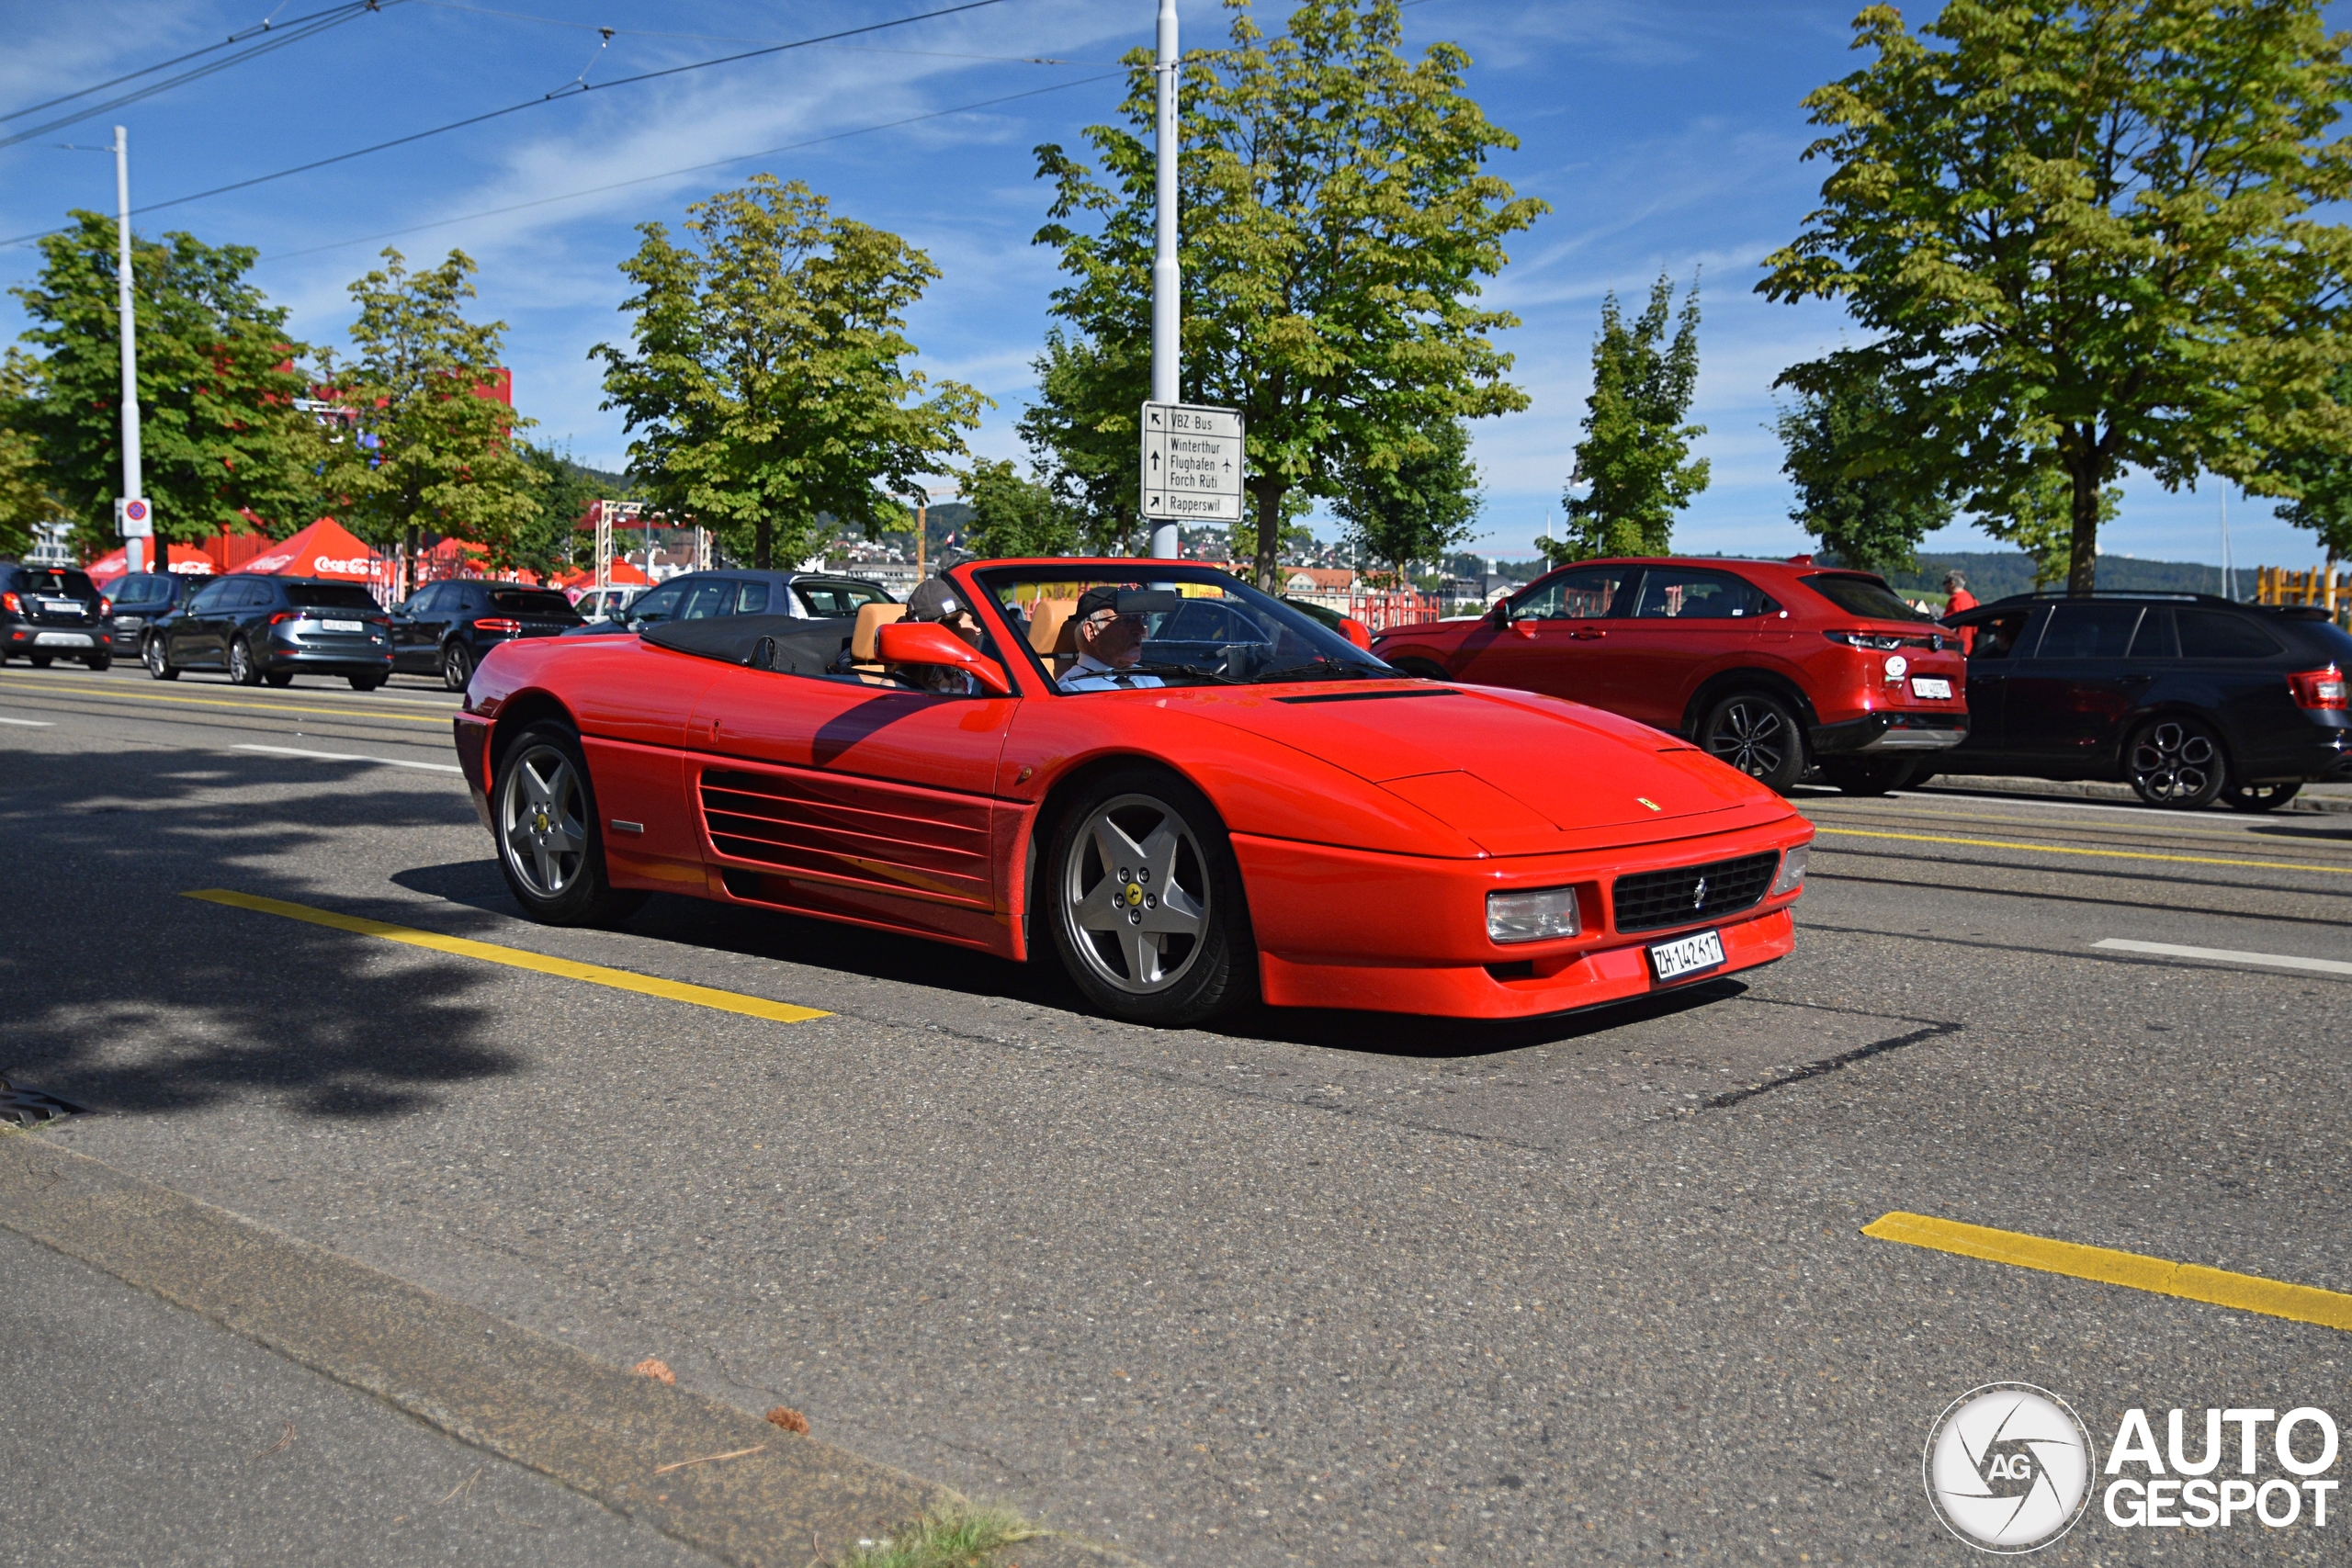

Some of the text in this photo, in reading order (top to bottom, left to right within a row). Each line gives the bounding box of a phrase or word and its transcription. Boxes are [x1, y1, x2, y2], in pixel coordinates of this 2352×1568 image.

[1170, 412, 1189, 428] VBZ
[1170, 437, 1220, 454] Winterthur
[1170, 455, 1216, 473] Flughafen
[1170, 472, 1217, 489] Forch Rüti
[1170, 496, 1220, 513] Rapperswil
